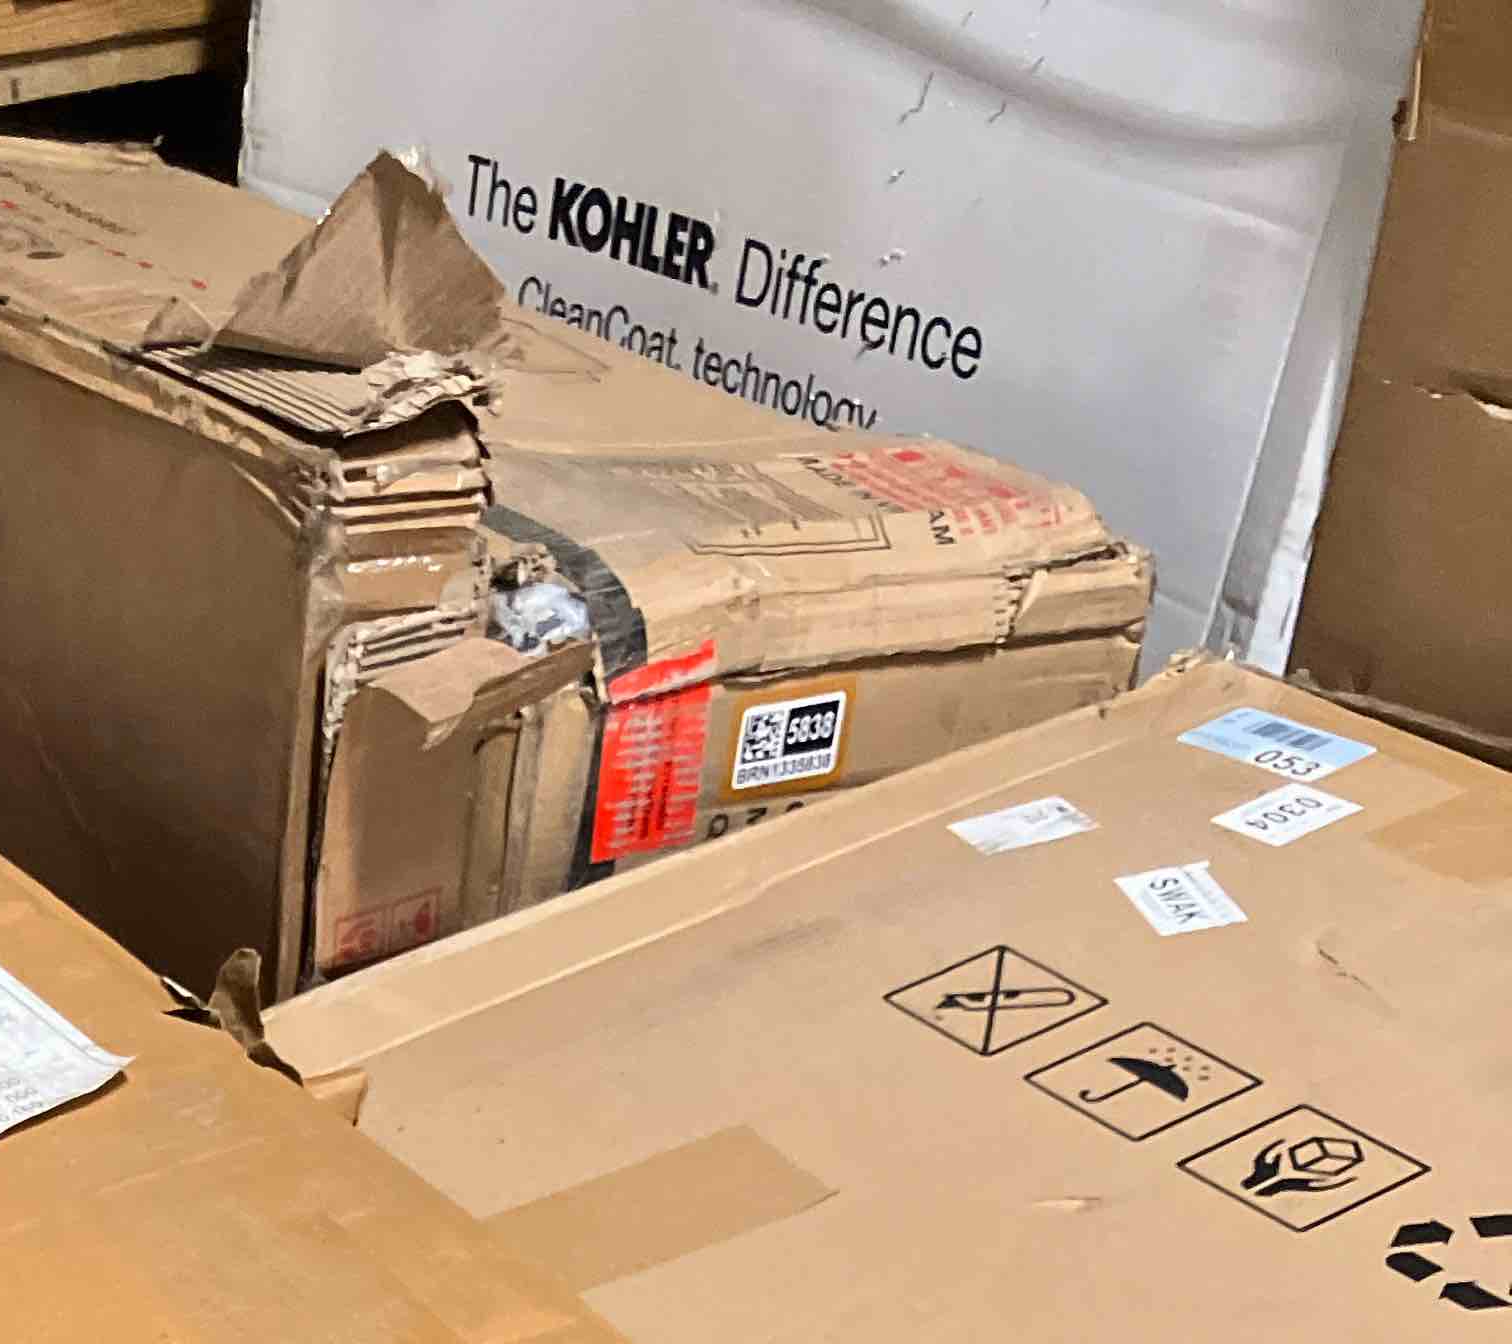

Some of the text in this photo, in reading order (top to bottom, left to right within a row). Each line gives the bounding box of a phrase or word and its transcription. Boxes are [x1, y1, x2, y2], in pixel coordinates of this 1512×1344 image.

[468, 154, 982, 379] The KOHLER Difference
[786, 711, 835, 744] 5838
[1255, 750, 1320, 776] 053
